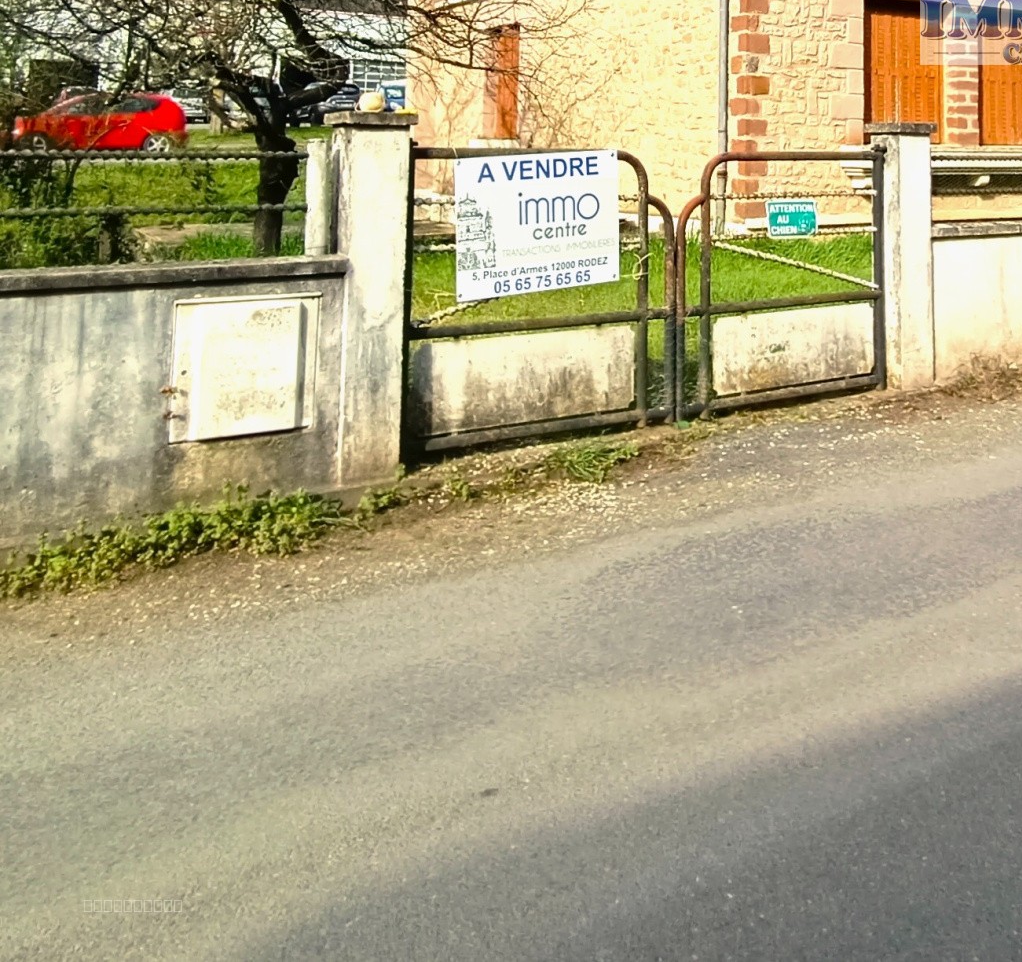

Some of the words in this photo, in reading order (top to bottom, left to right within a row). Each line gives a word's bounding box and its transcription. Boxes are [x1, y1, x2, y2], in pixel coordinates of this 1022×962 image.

[477, 162, 495, 183] A
[502, 156, 599, 181] VENDRE
[518, 192, 600, 225] immo
[769, 204, 813, 213] ATTENTION
[777, 215, 790, 224] AU
[532, 222, 587, 240] centre
[771, 225, 797, 235] CHIEN
[502, 243, 561, 257] TRANSACTIONS
[483, 269, 508, 280] Place
[511, 265, 548, 276] d'Armes
[551, 260, 576, 271] 12000
[577, 256, 608, 267] RODEZ
[494, 279, 510, 294] 05
[515, 277, 531, 291] 65
[536, 274, 551, 288] 75
[555, 272, 571, 286] 65
[575, 269, 591, 283] 65
